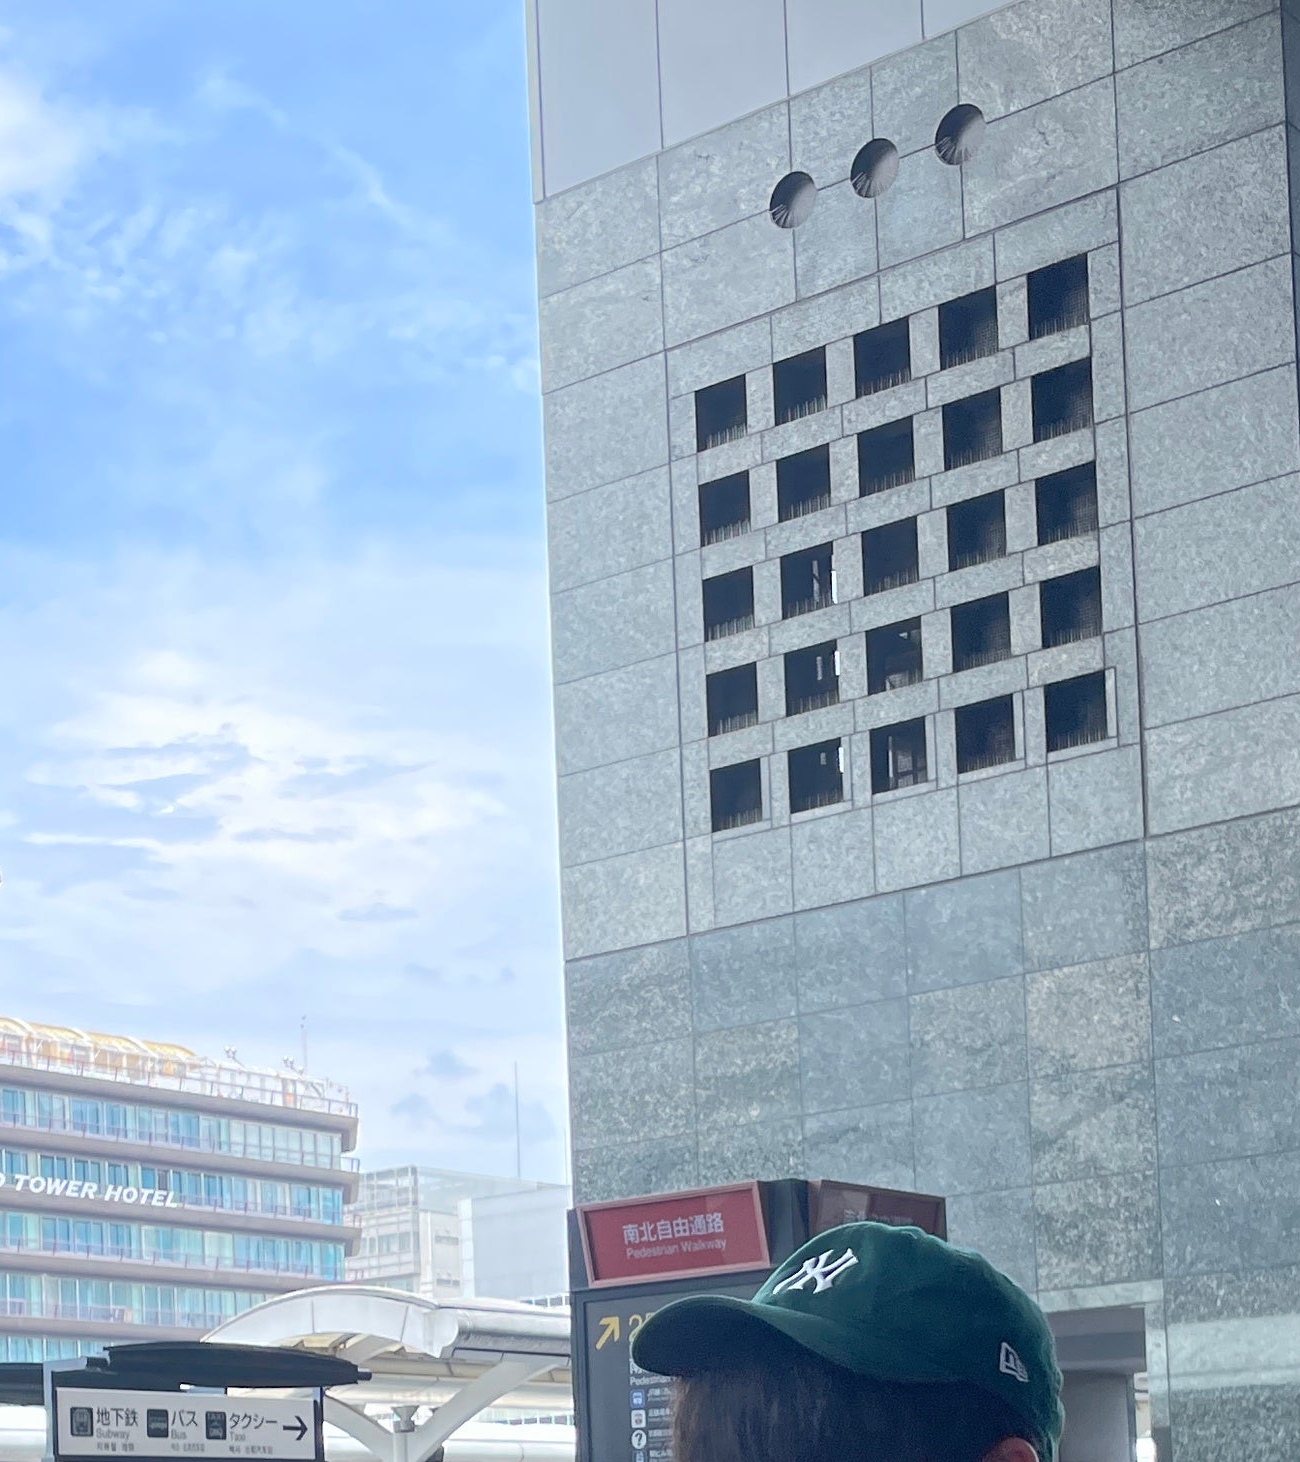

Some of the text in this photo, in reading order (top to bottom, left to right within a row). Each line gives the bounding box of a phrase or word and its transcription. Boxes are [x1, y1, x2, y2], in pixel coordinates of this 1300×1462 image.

[13, 1173, 98, 1200] TOWER
[103, 1185, 179, 1208] HOTEL
[622, 1211, 725, 1245] 南北自由通路
[626, 1237, 727, 1260] Pedestrian Walkway
[96, 1407, 139, 1427] 地下鉄
[171, 1409, 199, 1427] バス
[229, 1412, 278, 1430] タクシー
[96, 1428, 130, 1441] Subway
[171, 1429, 187, 1440] Bus
